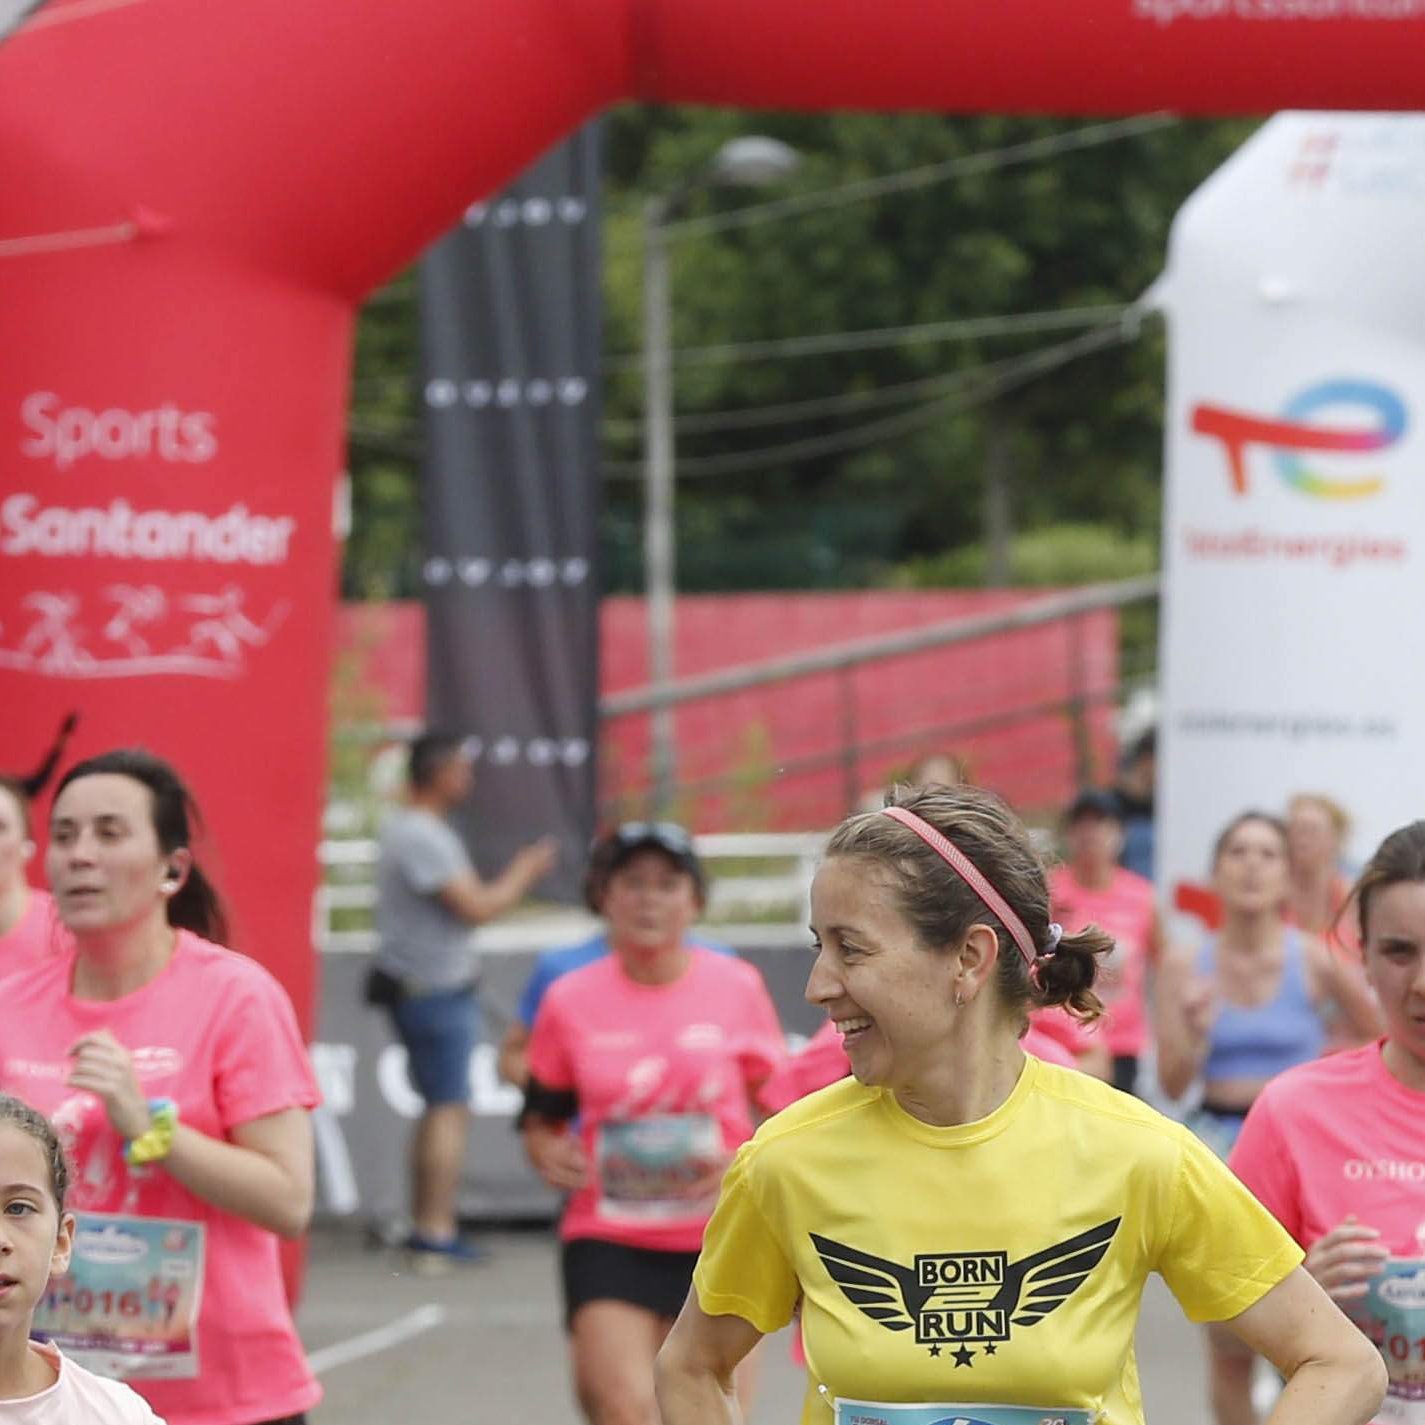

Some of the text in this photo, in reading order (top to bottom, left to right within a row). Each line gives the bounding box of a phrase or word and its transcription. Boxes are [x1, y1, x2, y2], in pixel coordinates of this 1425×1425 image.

[20, 391, 218, 470] Sports
[0, 492, 296, 566] Santander
[925, 1257, 1002, 1284] BORN
[75, 1287, 142, 1318] 016
[925, 1310, 1003, 1338] RUN
